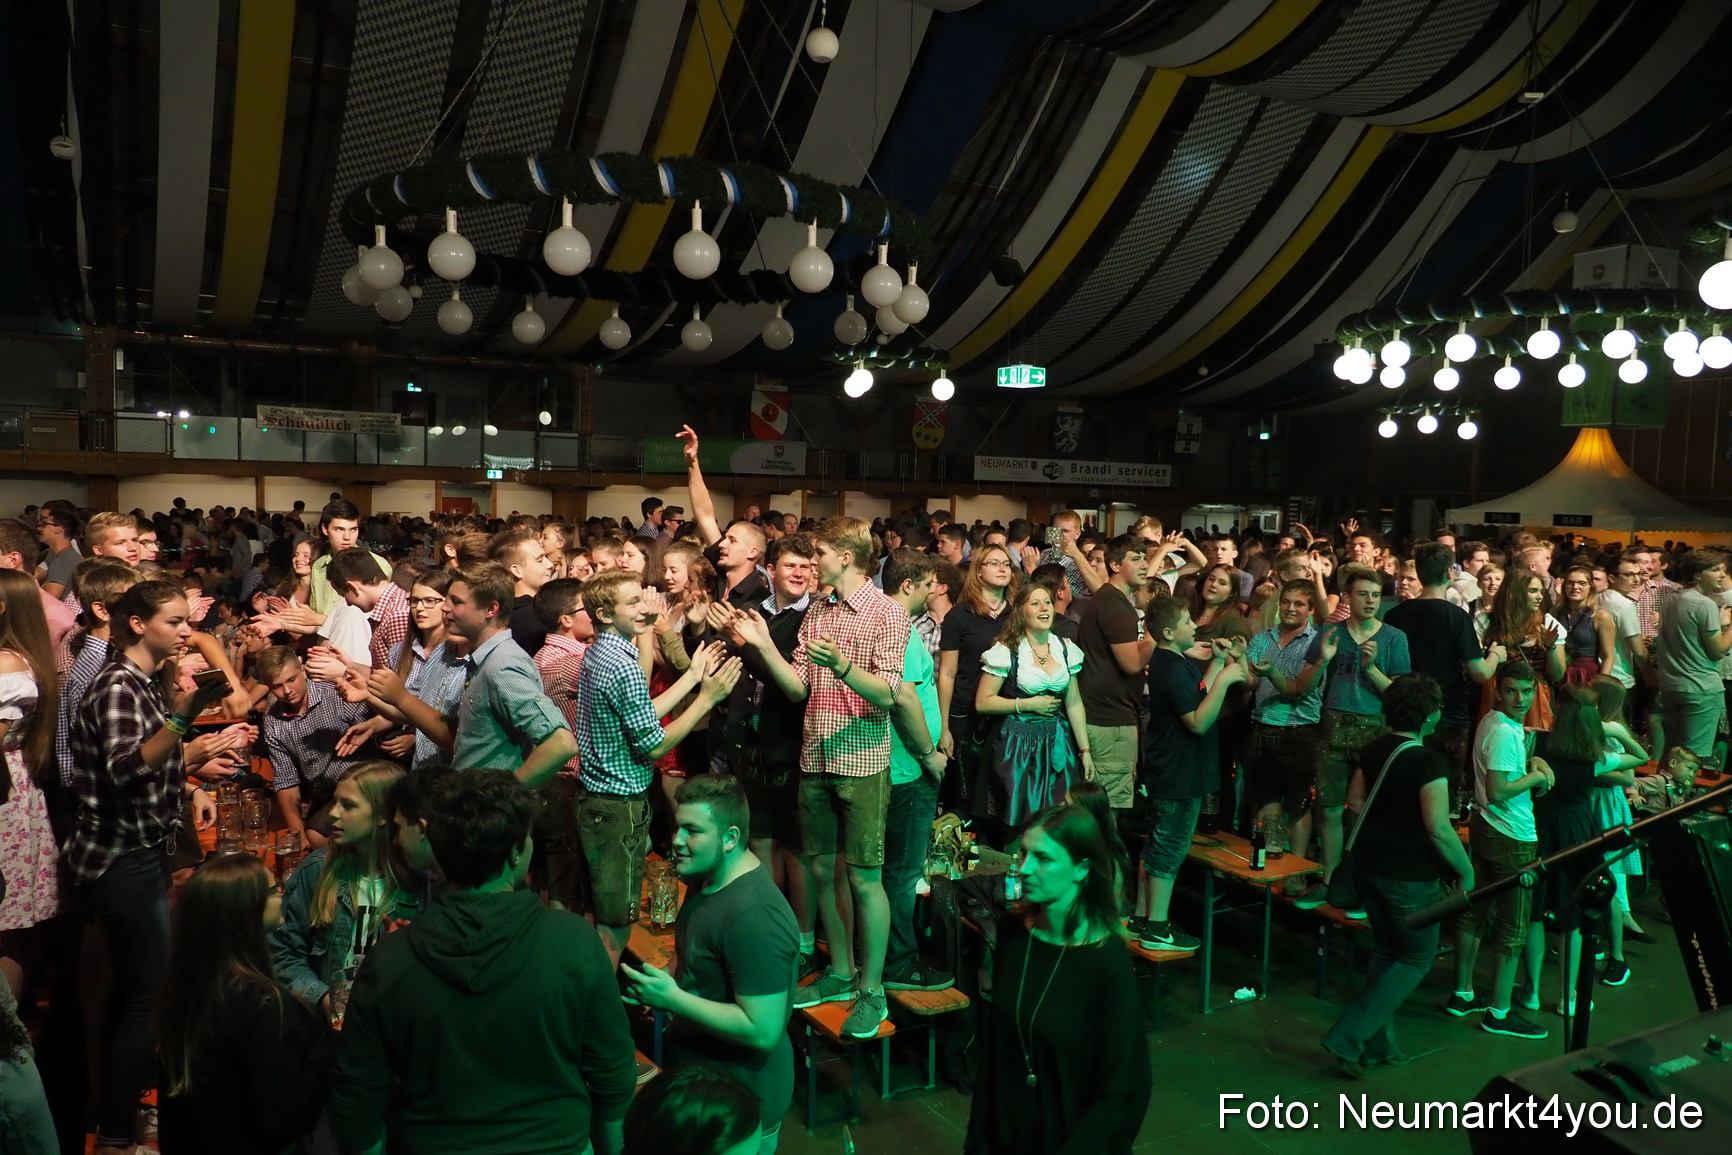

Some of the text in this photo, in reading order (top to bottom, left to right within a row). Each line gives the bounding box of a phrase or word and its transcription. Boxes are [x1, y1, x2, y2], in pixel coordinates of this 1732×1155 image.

[655, 456, 711, 466] Willkoen
[980, 458, 1029, 470] NEUMARKT
[1070, 463, 1167, 477] Brandl services
[1562, 516, 1583, 525] BAR
